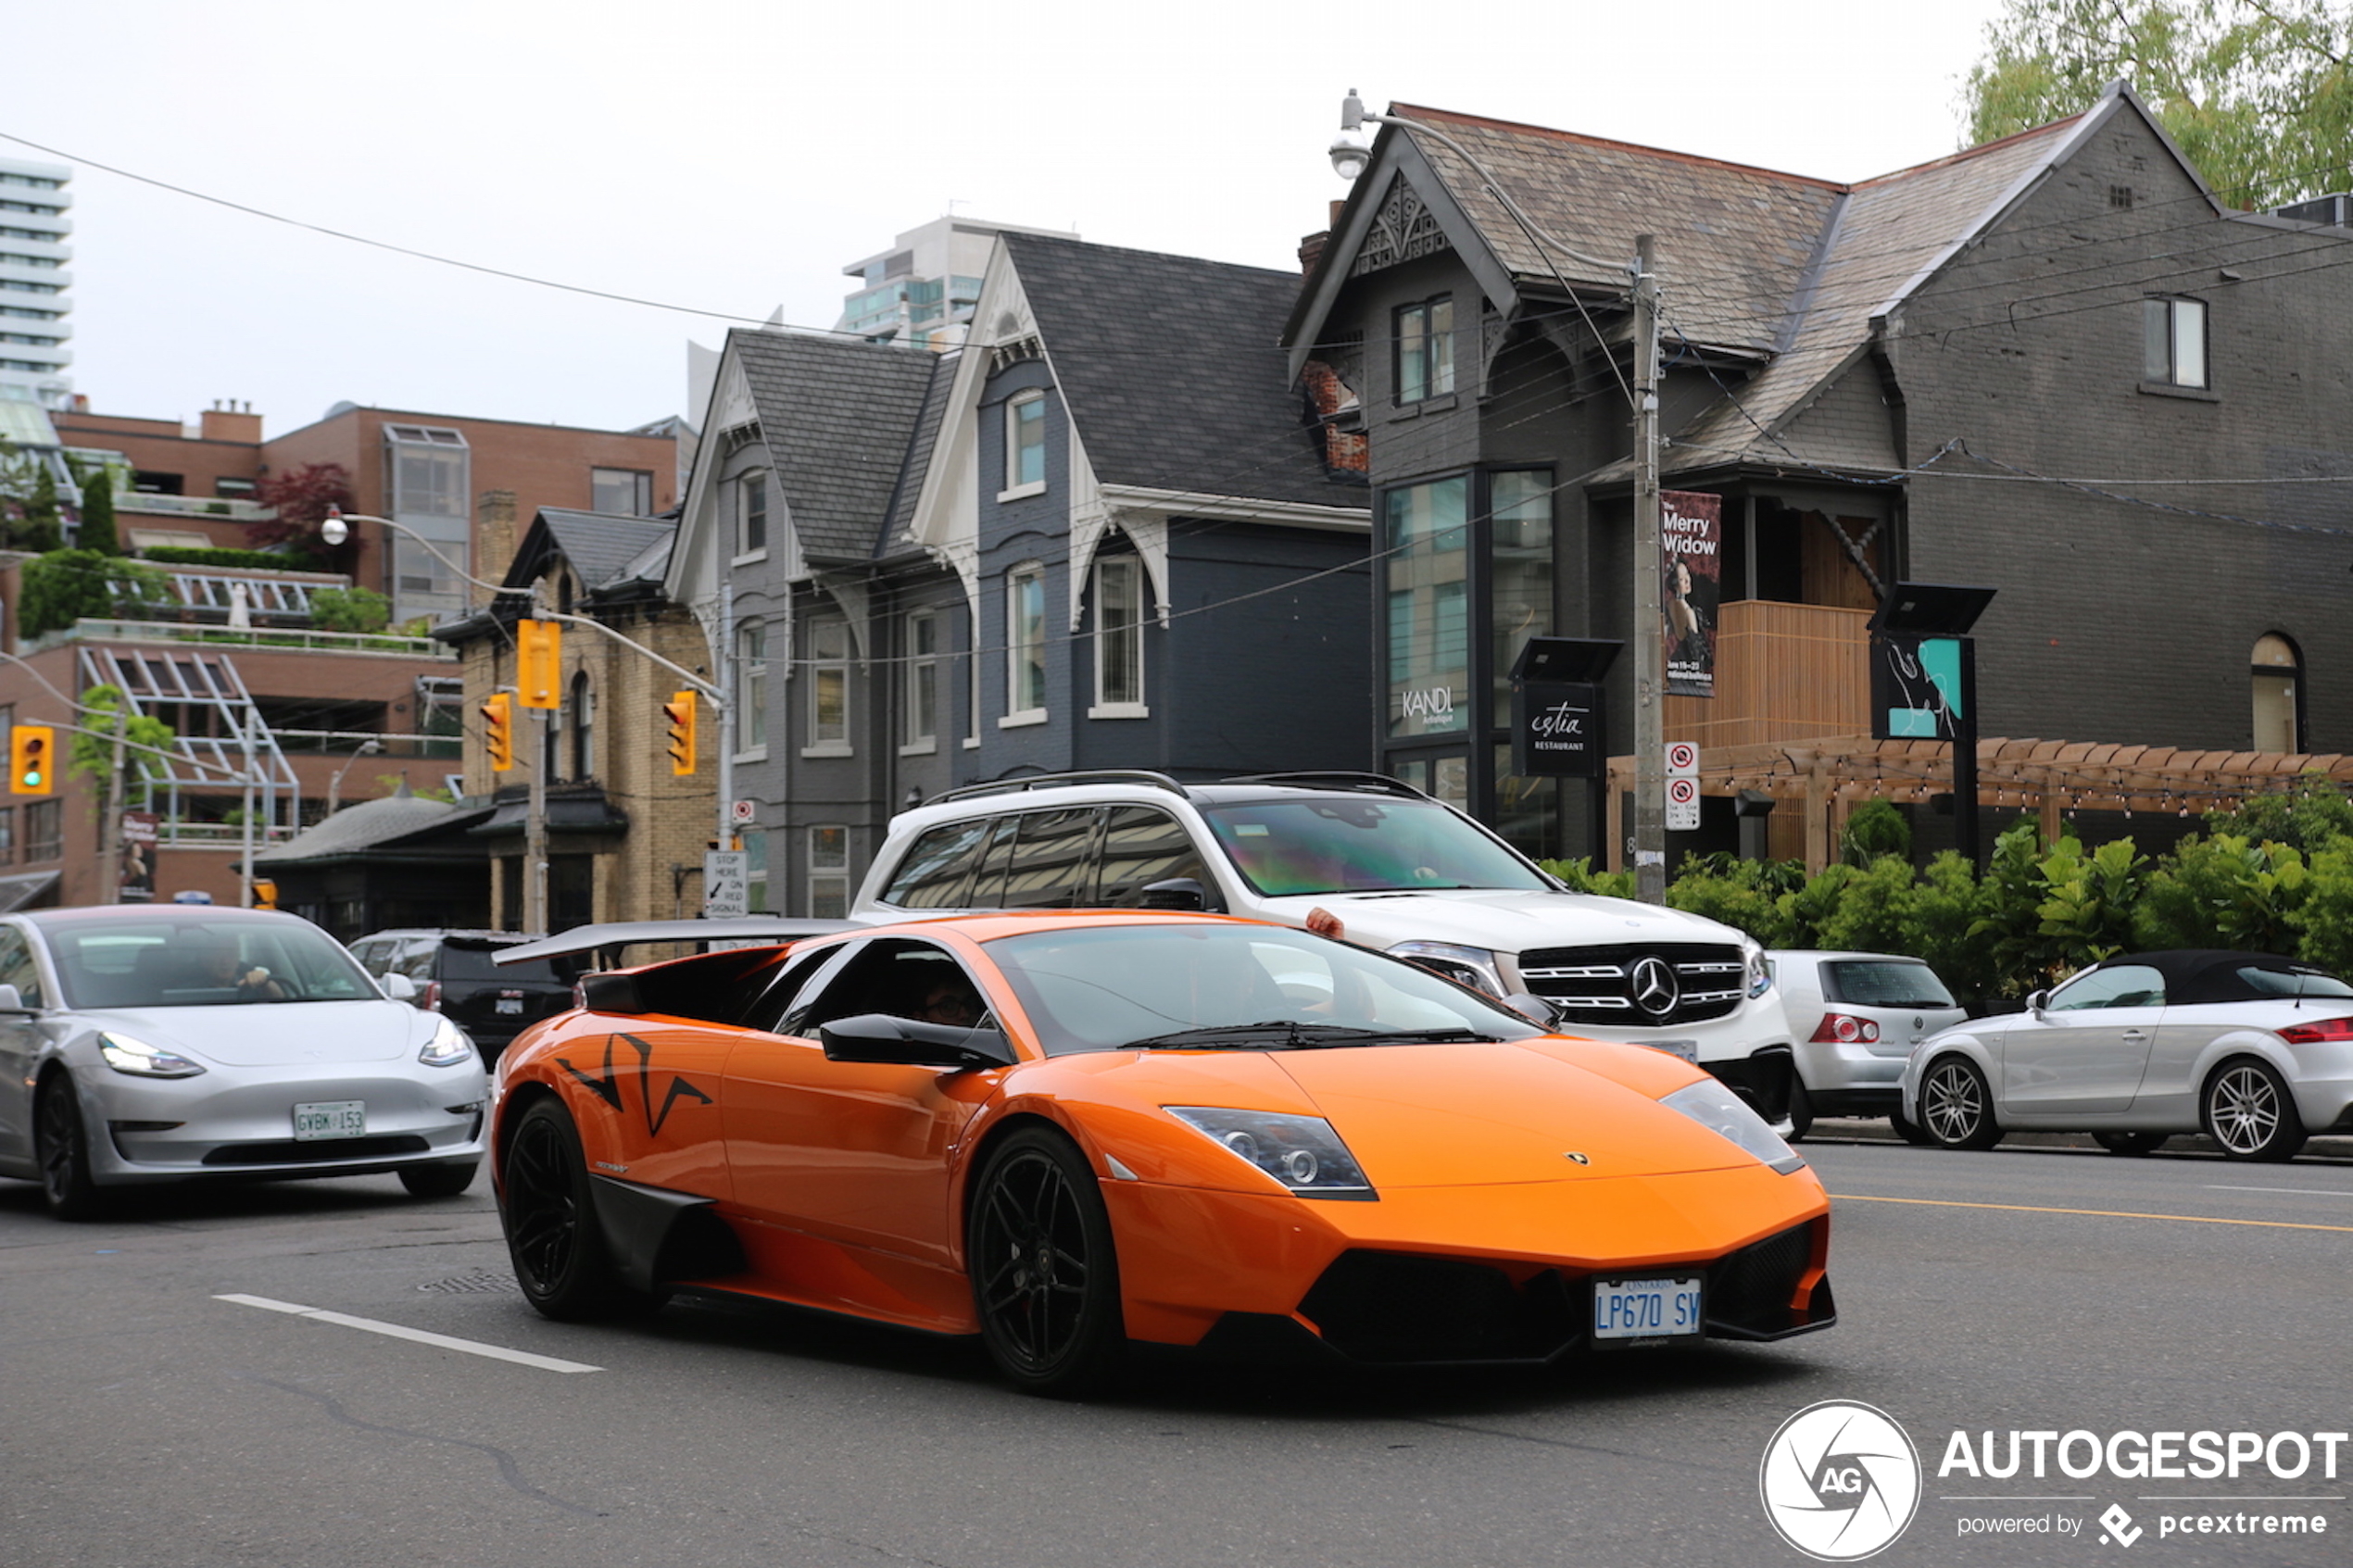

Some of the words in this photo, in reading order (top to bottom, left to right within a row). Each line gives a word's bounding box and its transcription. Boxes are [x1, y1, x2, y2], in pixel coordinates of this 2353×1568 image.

[1664, 511, 1709, 537] Merry
[1663, 533, 1717, 556] Widow
[1535, 741, 1584, 751] RESTAURANT
[716, 856, 738, 864] STOP
[715, 868, 738, 877] HERE
[730, 881, 743, 889] ON
[724, 892, 742, 901] RED
[711, 904, 743, 913] SIGNAL
[340, 1111, 363, 1129] 153
[1627, 1280, 1672, 1292] ONTARIO
[1597, 1294, 1662, 1329] LP670
[1675, 1292, 1702, 1326] SV
